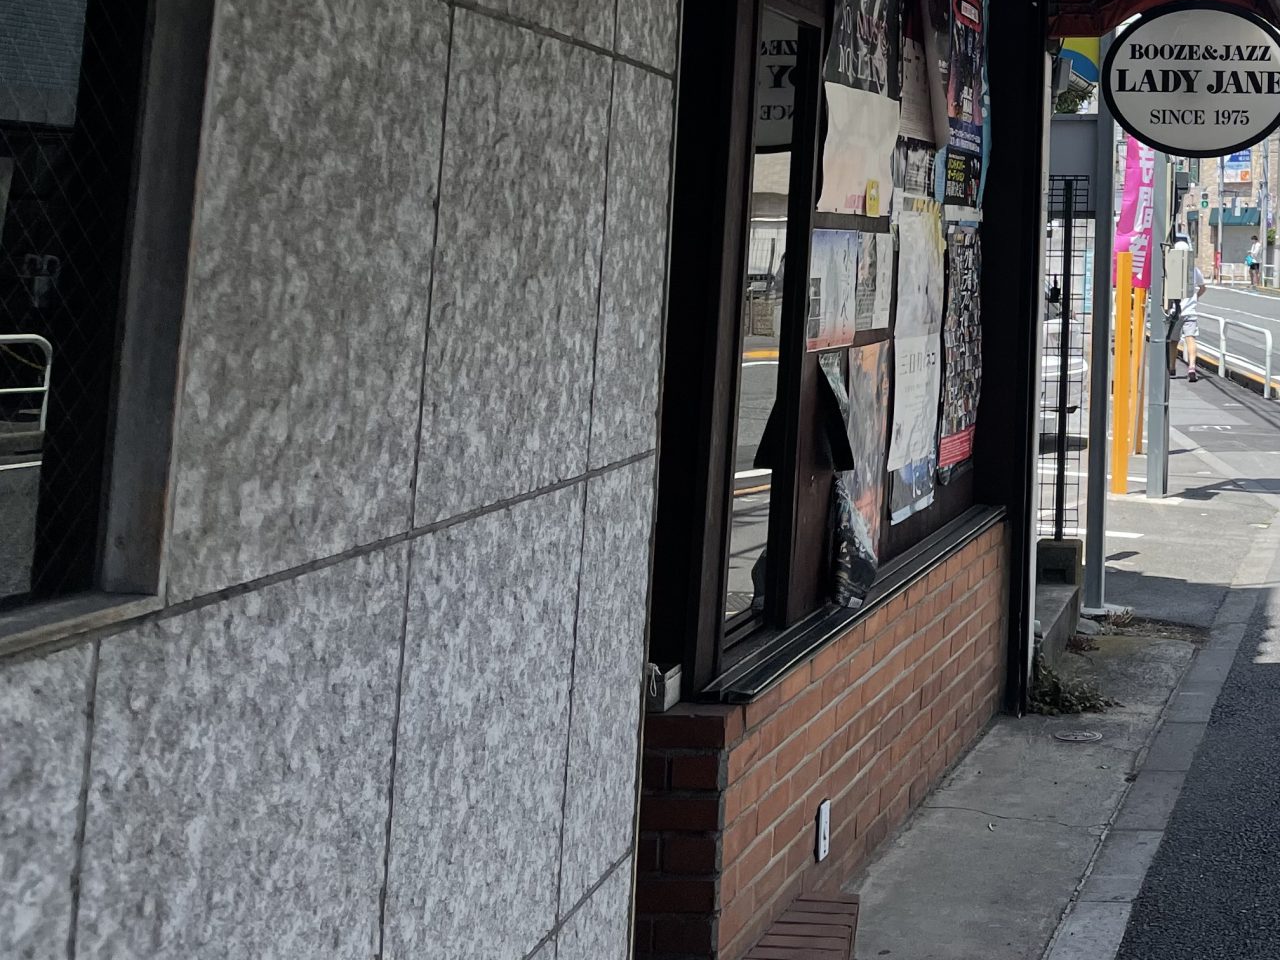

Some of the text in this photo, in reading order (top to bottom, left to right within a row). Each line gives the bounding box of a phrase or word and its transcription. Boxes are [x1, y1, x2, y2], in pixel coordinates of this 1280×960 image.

[1129, 43, 1272, 62] BOOZE&JAZZ
[1116, 68, 1203, 93] LADY
[1149, 109, 1250, 126] SINCE 1975
